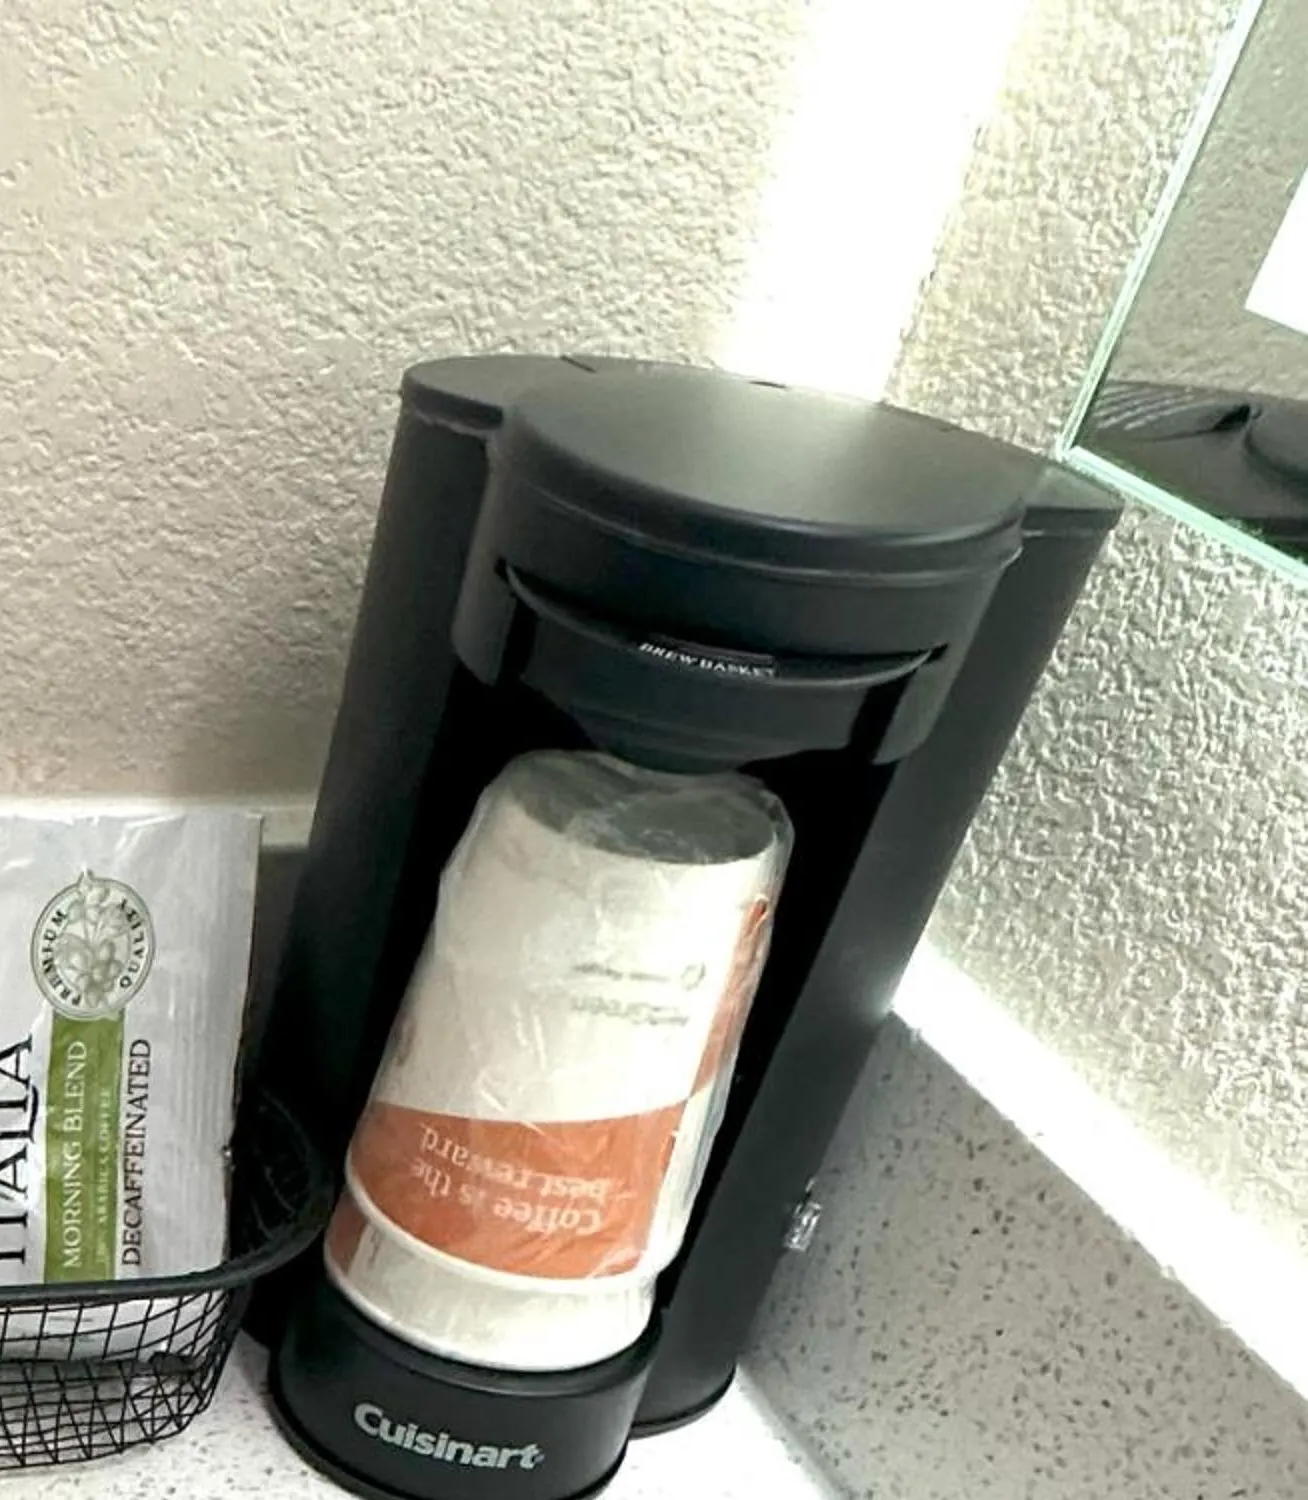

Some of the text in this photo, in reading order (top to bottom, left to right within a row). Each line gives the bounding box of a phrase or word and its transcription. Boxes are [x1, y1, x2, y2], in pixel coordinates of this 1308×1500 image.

[639, 642, 775, 678] BREW BASKET
[41, 909, 82, 1006] PREMIUM
[119, 898, 146, 989] QUALITY
[62, 1040, 88, 1269] MORNING BLEND
[121, 1038, 152, 1266] DECAFFEINATED
[410, 1156, 452, 1198] the
[493, 1195, 603, 1236] Coffee
[539, 1172, 612, 1206] best
[353, 1402, 541, 1470] Cuisinart
